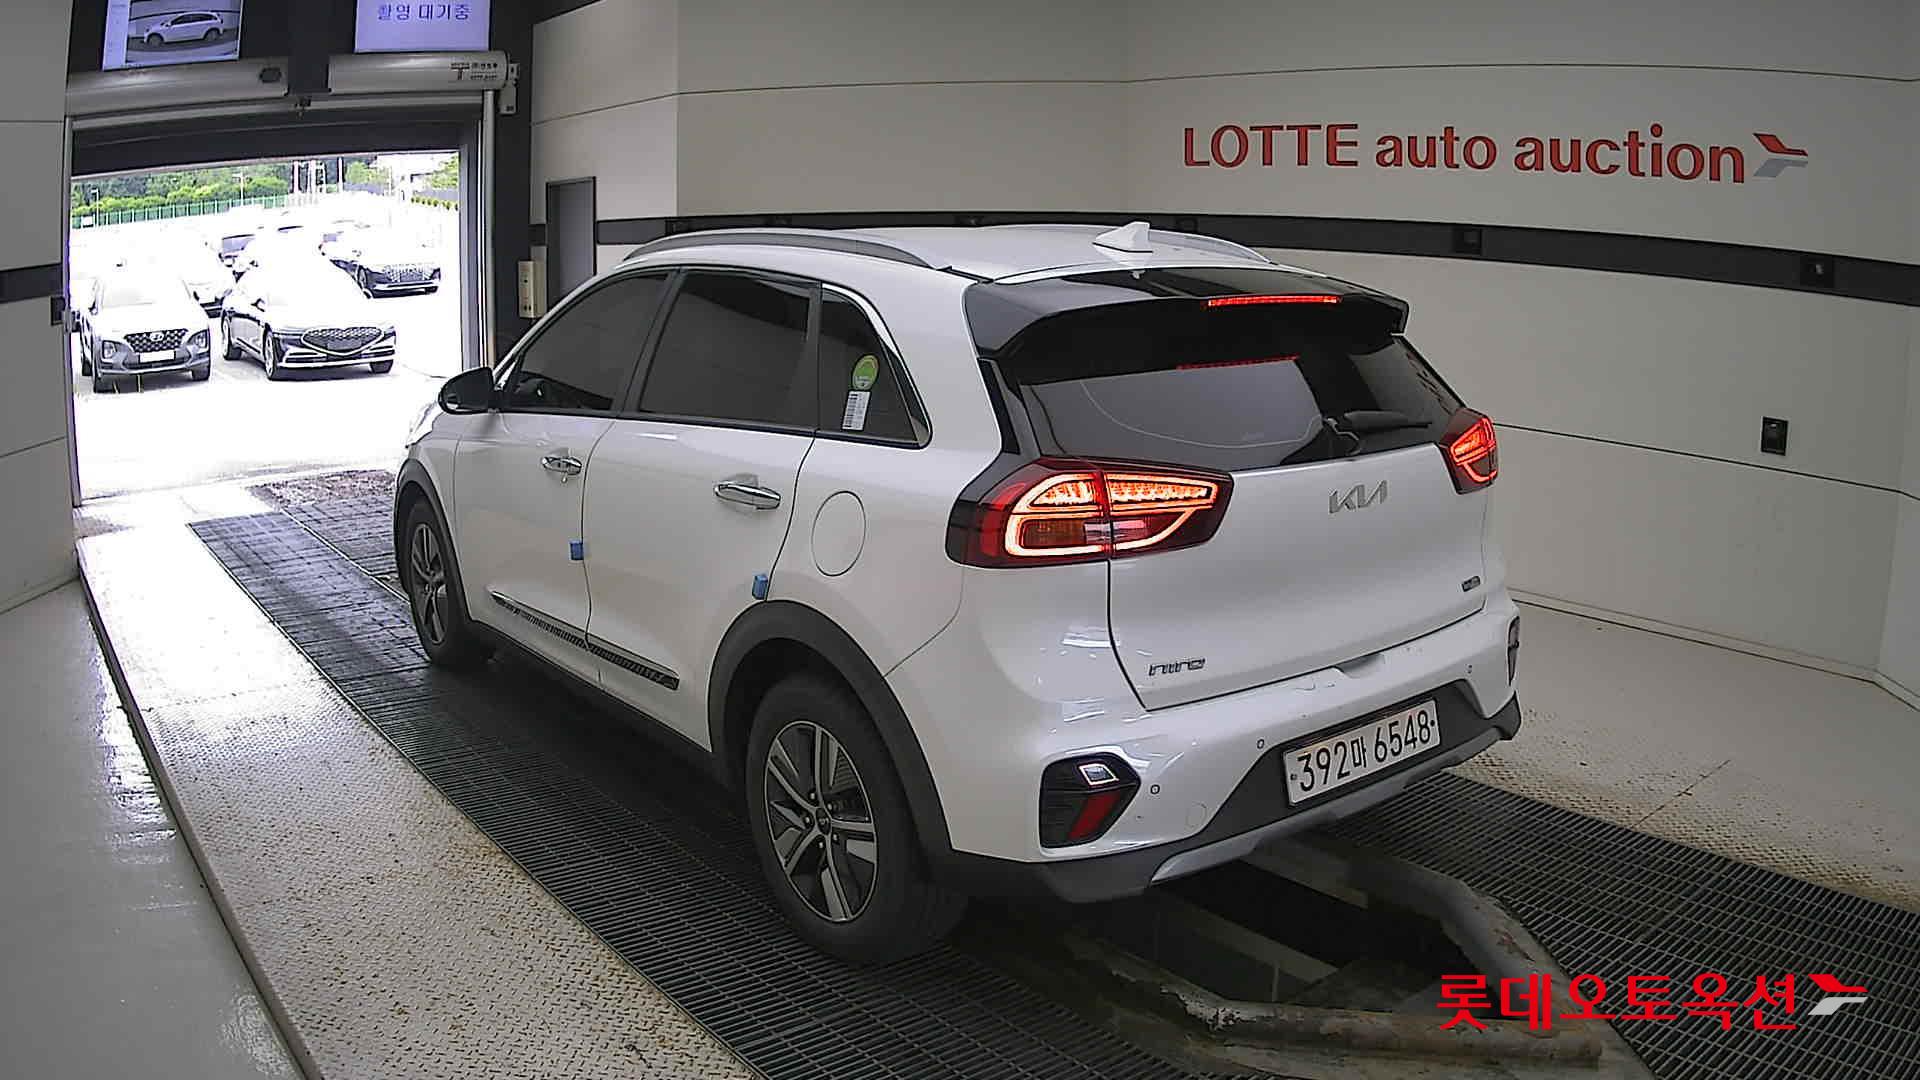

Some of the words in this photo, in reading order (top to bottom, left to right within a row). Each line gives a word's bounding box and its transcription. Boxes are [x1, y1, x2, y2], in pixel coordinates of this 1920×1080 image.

[418, 4, 472, 21] 대기중
[1184, 124, 1358, 168] LOTTE
[1375, 126, 1498, 170] auto
[1513, 123, 1745, 184] auction
[1297, 736, 1367, 792] 392마
[1374, 709, 1431, 763] 6548
